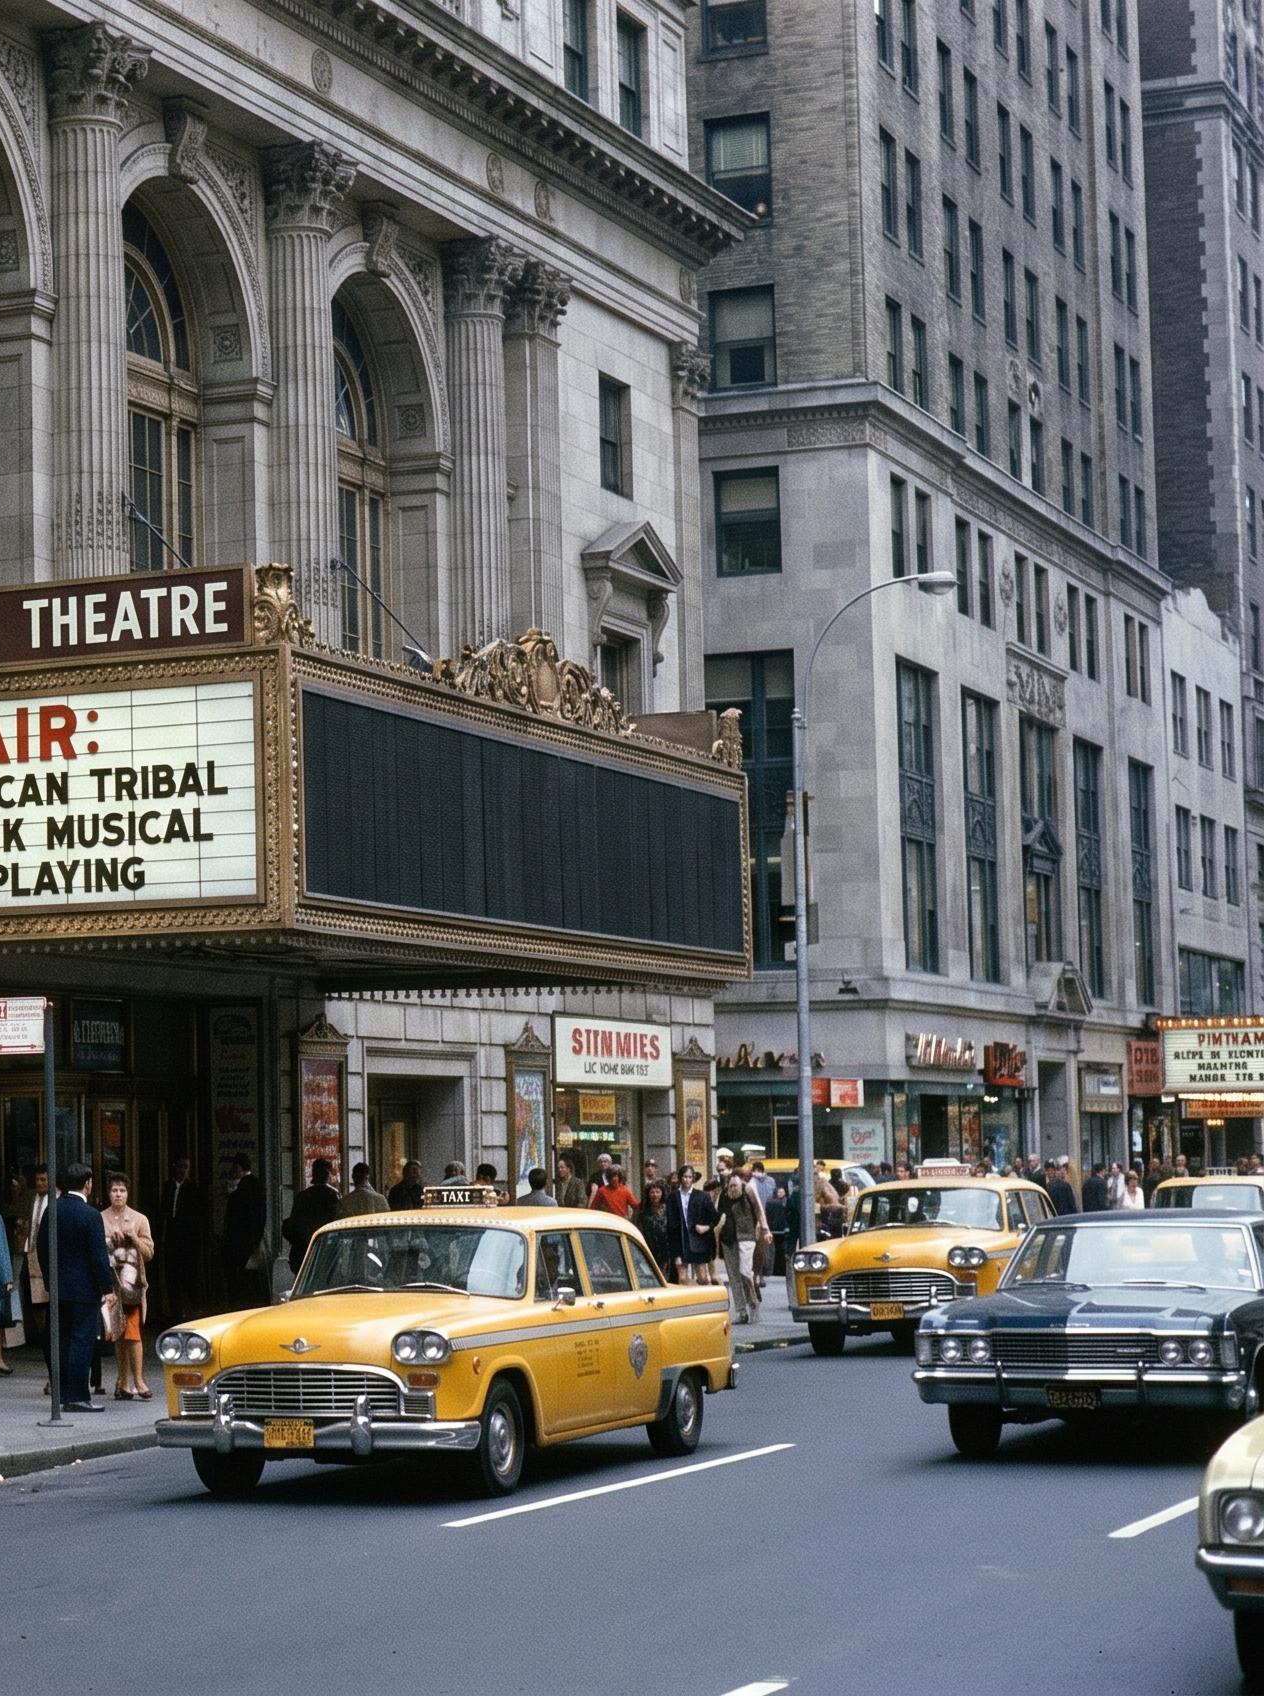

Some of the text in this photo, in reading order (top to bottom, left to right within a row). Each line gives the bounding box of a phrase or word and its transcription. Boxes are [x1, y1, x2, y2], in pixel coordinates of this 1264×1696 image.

[22, 581, 229, 649] THEATRE
[89, 760, 229, 804] TRIBAL
[46, 807, 214, 850] MUSICAL
[441, 1190, 471, 1203] TAXI
